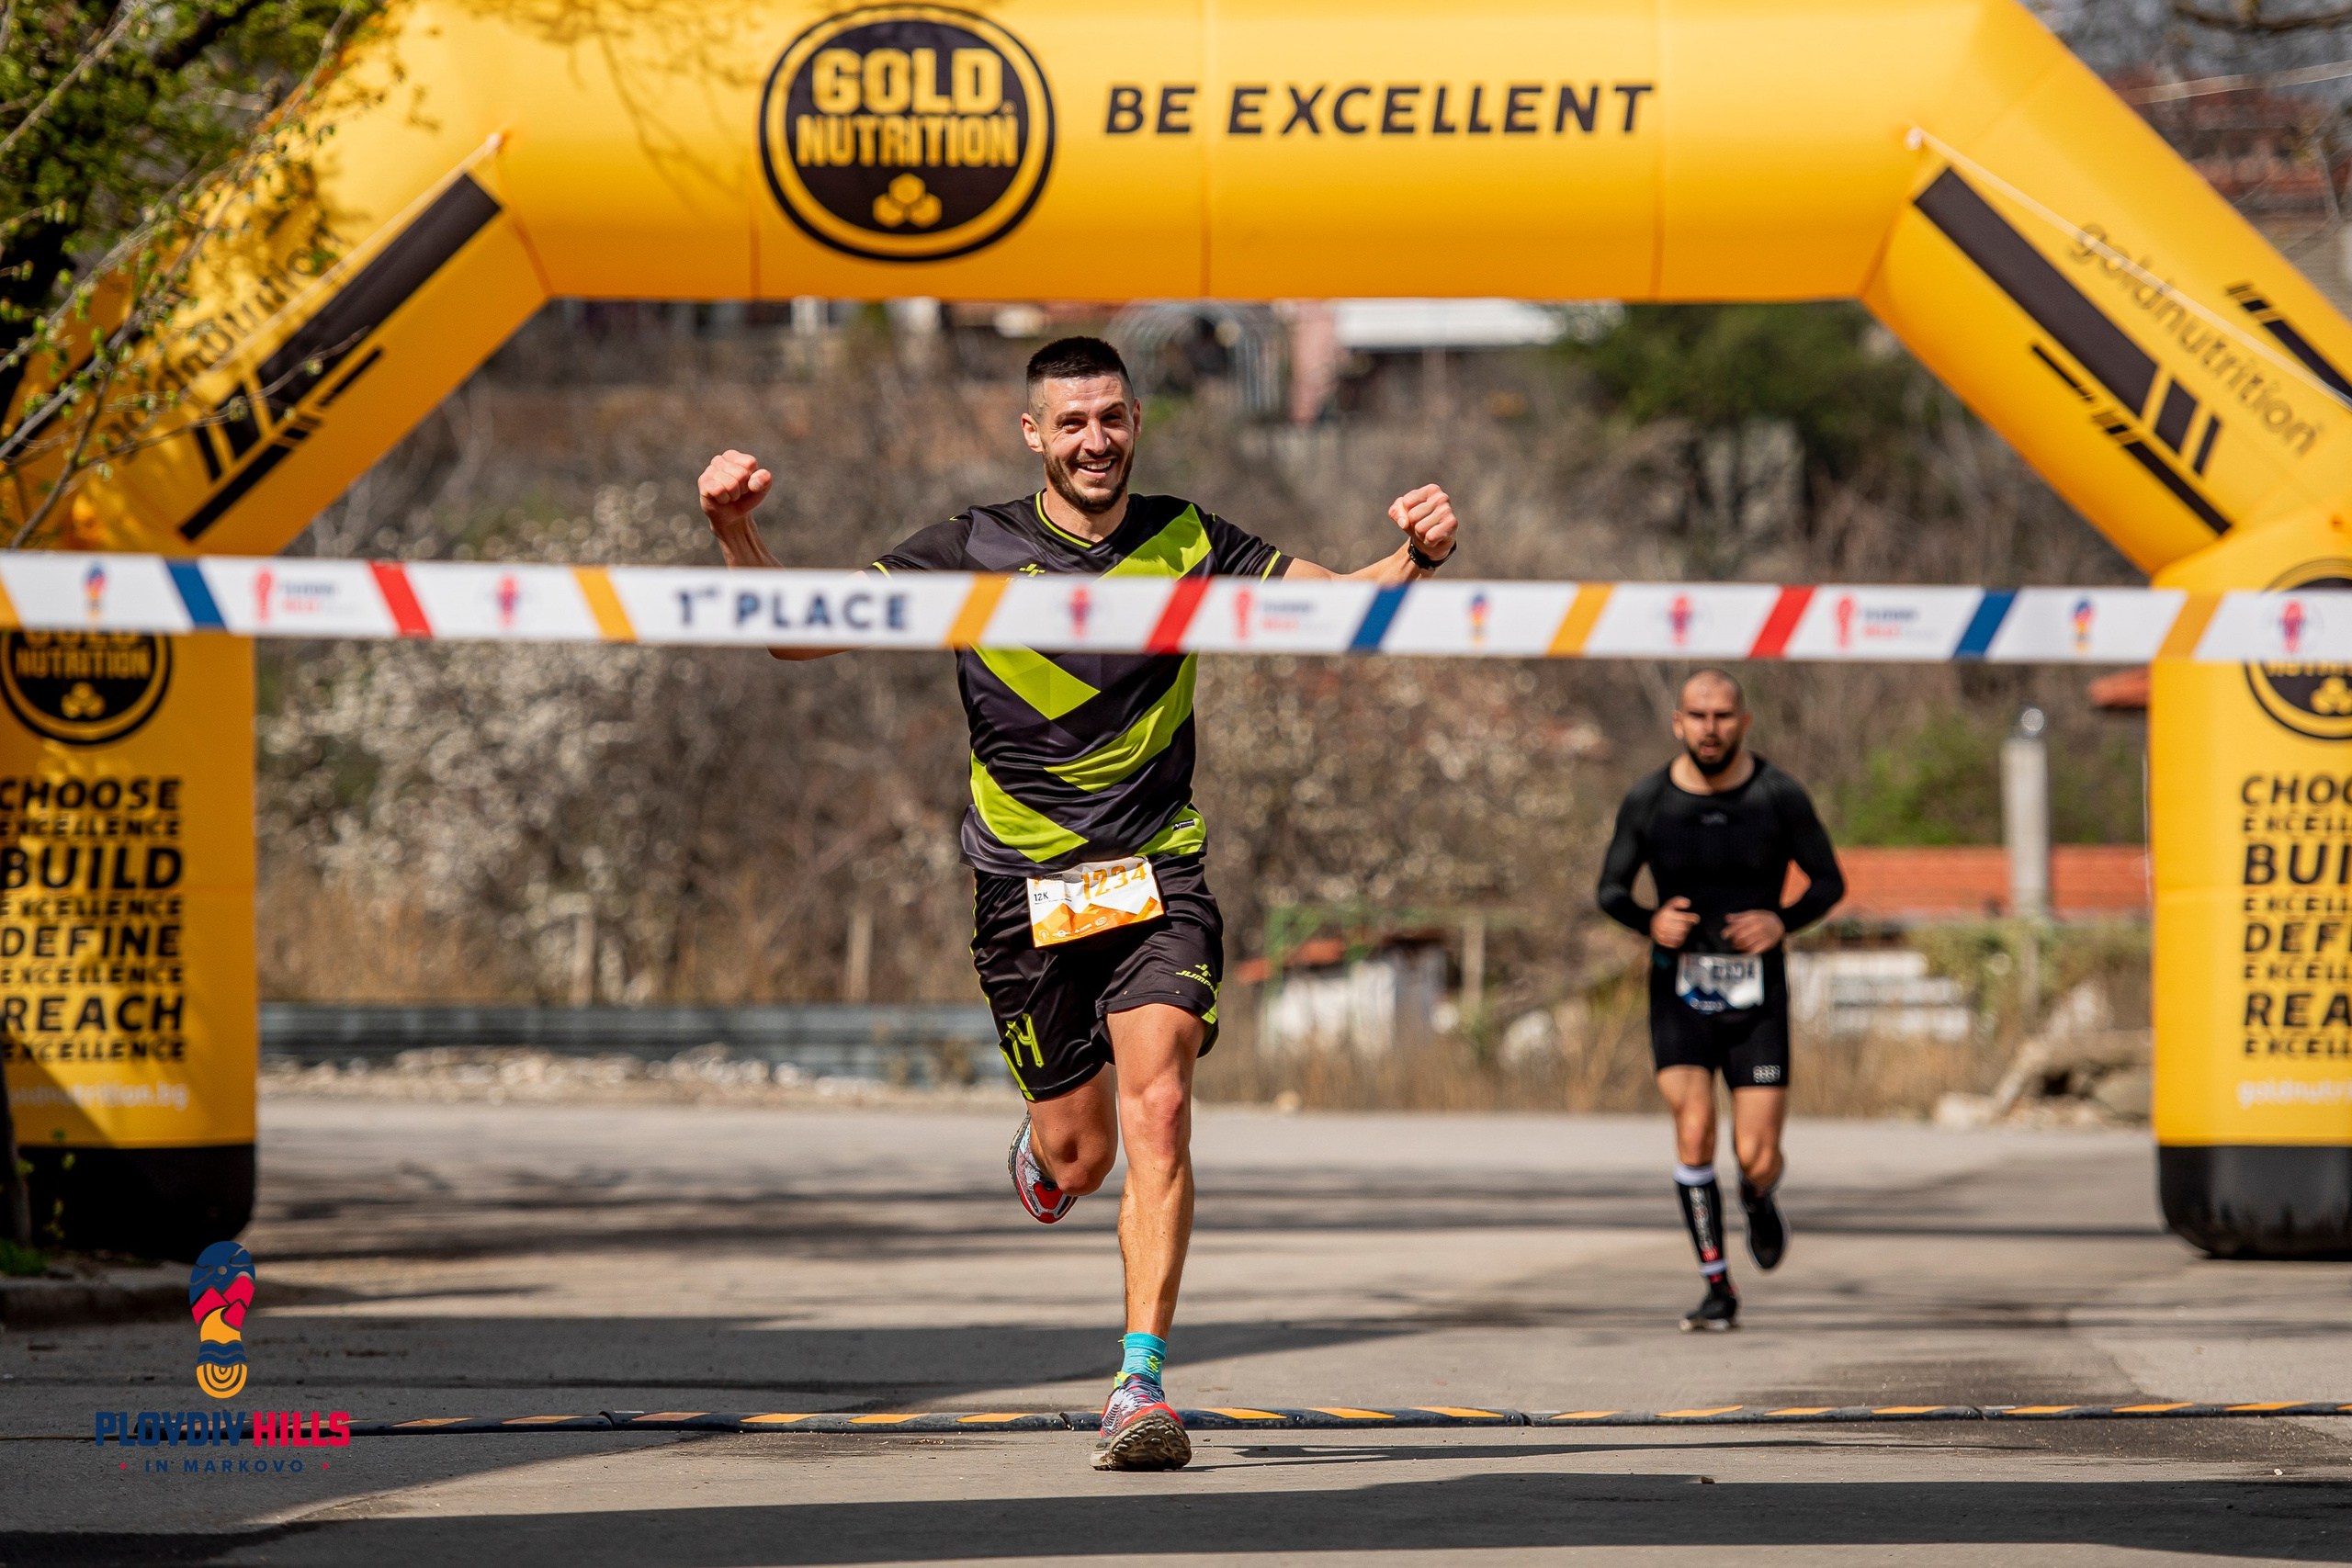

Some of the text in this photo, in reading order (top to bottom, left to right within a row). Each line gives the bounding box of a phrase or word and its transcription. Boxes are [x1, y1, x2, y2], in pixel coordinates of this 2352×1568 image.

[812, 48, 1003, 115] GOLD
[1106, 85, 1654, 135] BE EXCELLENT
[796, 114, 1019, 167] NUTRITION
[734, 590, 909, 630] PLACE
[15, 645, 153, 679] NUTRITION
[0, 778, 182, 810] CHOOSE
[0, 846, 183, 889] BUILD
[1080, 862, 1148, 900] 1234
[1, 925, 181, 957] DEFINE
[3, 996, 184, 1032] REACH
